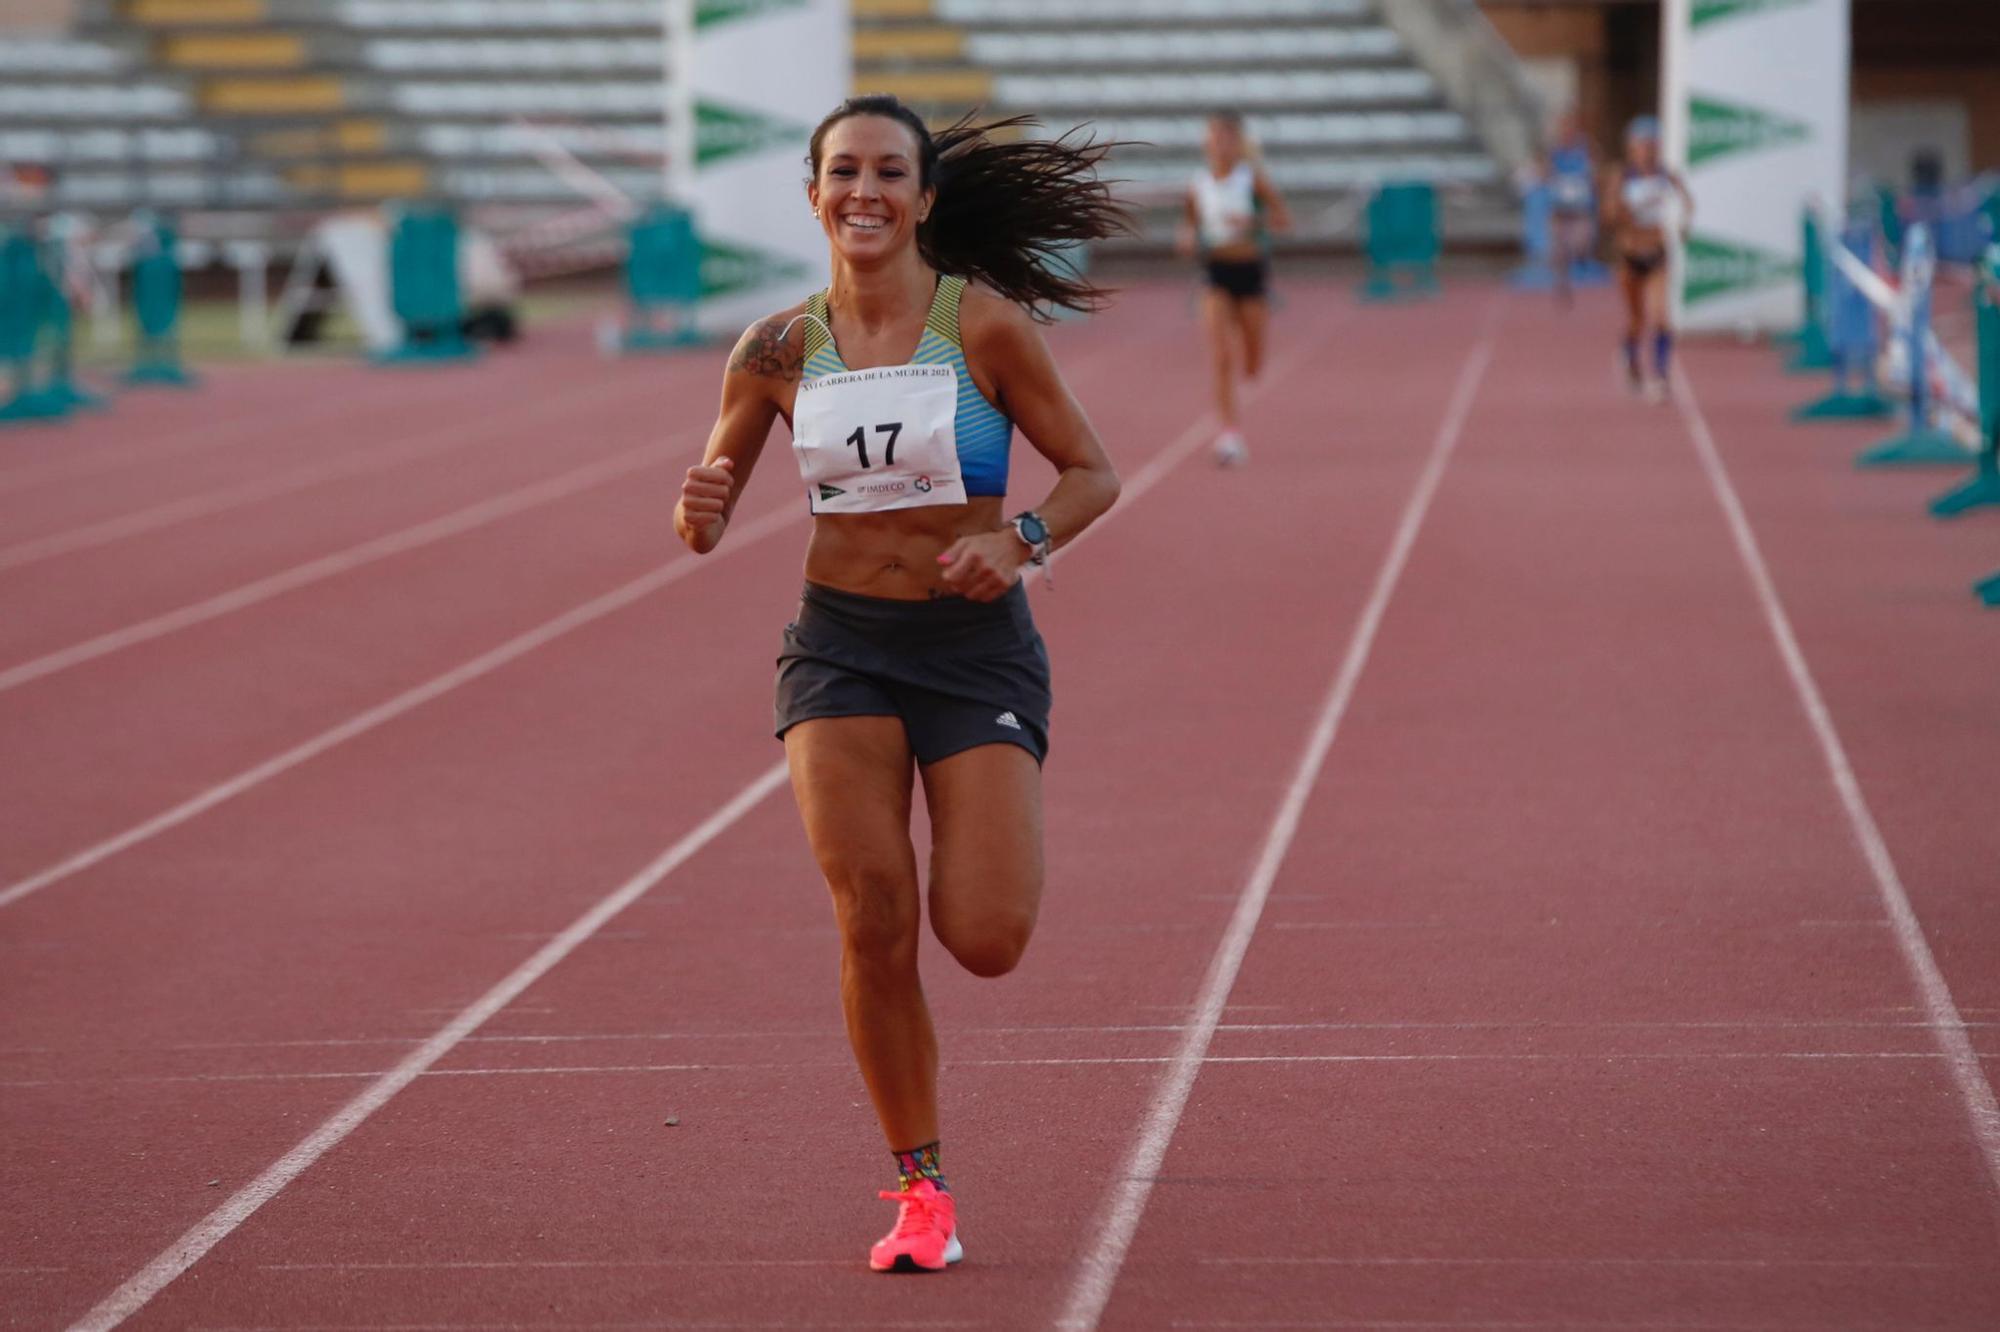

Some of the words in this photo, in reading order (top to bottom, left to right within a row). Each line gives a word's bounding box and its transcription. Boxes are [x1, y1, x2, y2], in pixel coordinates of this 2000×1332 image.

[819, 375, 863, 388] CARRERA
[864, 372, 876, 381] DE
[880, 370, 892, 379] LA
[895, 368, 930, 377] MUJER
[931, 368, 950, 377] 2021
[846, 422, 903, 469] 17
[866, 482, 905, 493] IMDECO
